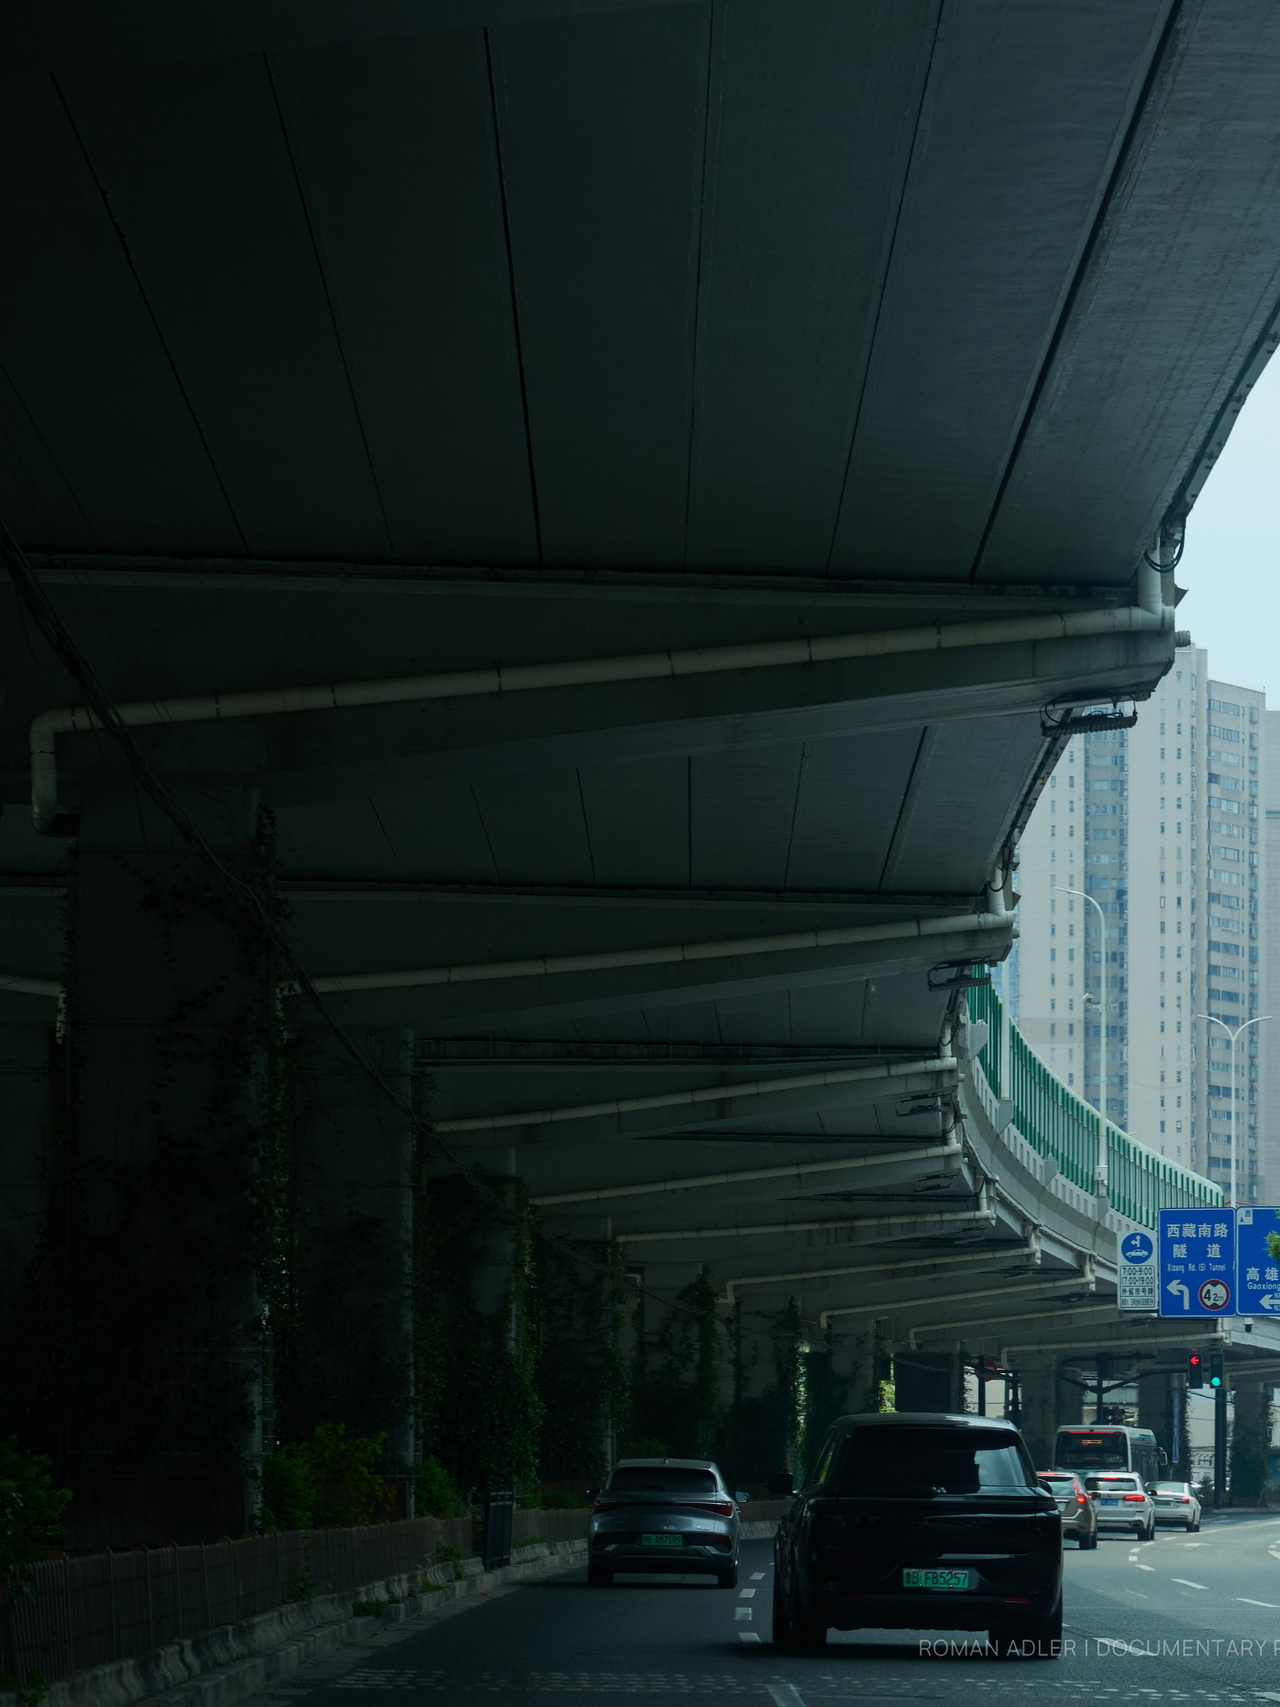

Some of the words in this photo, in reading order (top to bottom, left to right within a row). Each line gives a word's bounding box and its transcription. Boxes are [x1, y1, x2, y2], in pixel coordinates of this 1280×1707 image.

[1166, 1223, 1229, 1238] 西藏南路
[1172, 1243, 1222, 1259] 隧道
[1122, 1267, 1153, 1276] 7:00-9:00
[1167, 1263, 1185, 1274] Xizang
[1198, 1263, 1206, 1271] (S)
[1208, 1263, 1226, 1271] Tunnel
[1121, 1276, 1154, 1285] 17:00-19:00
